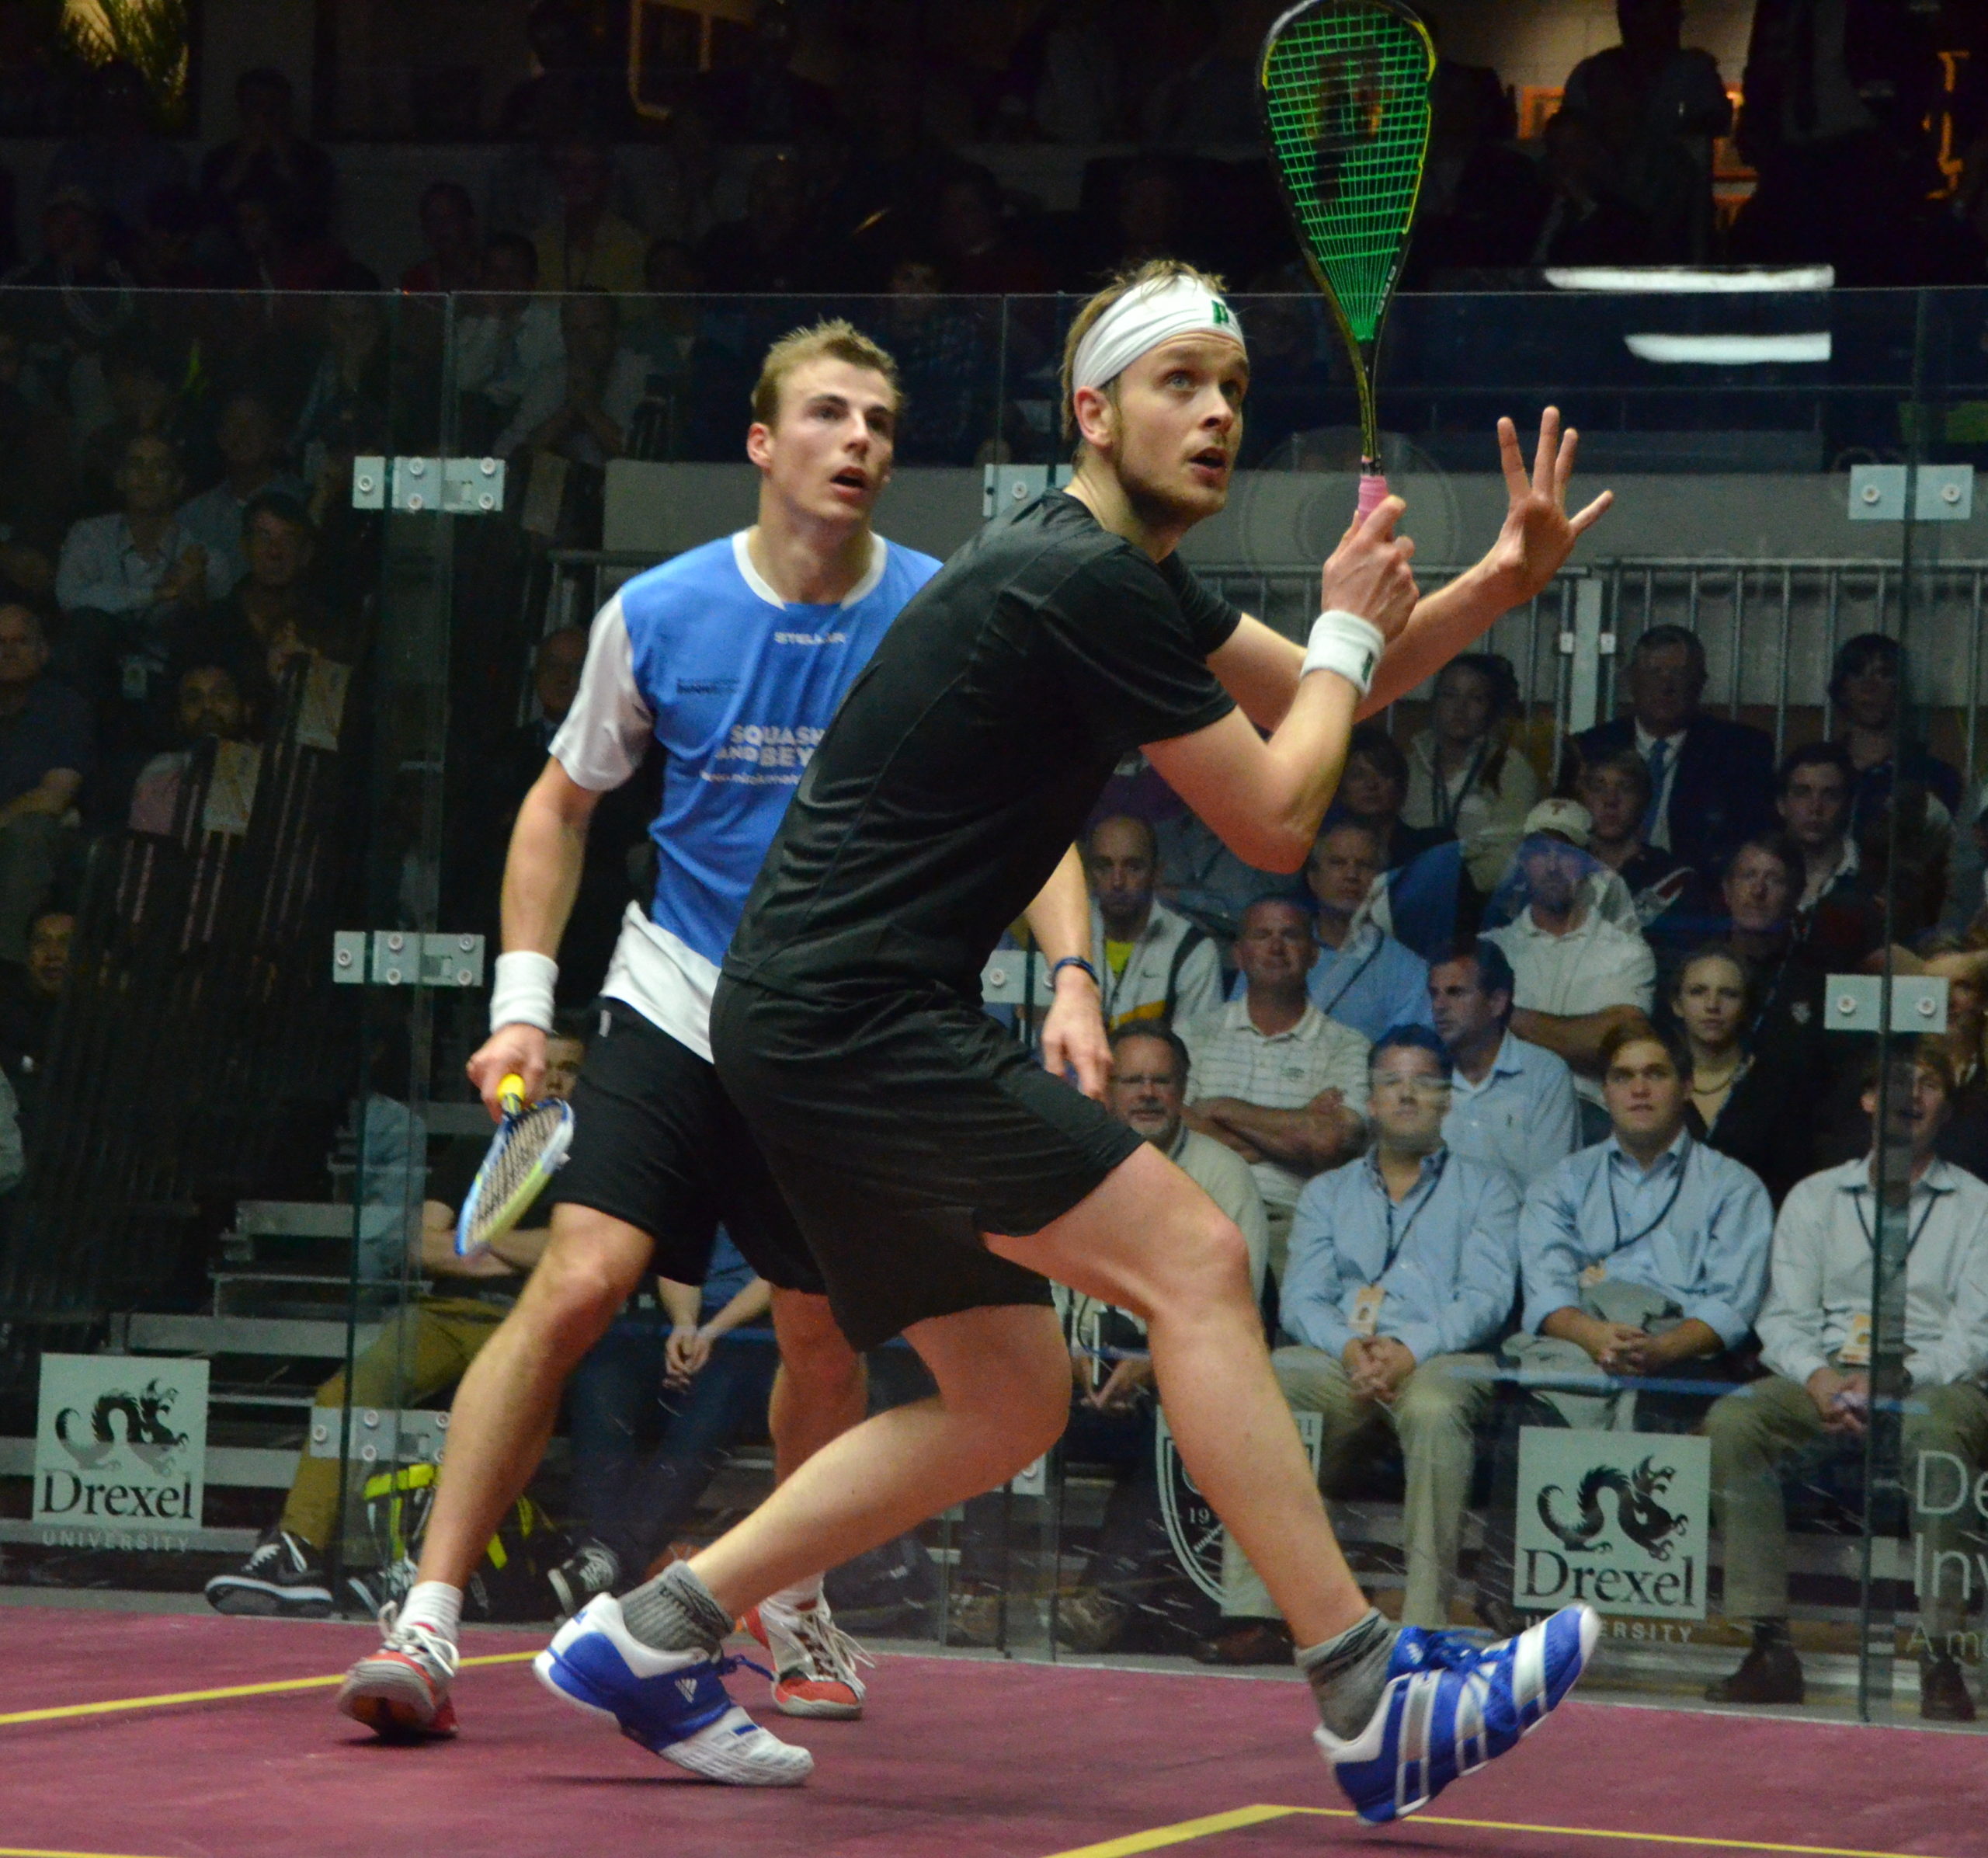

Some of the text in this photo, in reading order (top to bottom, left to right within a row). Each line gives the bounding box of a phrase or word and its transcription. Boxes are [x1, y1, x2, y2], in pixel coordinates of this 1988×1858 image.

[40, 1467, 194, 1519] Drexel
[42, 1529, 189, 1553] UNIVERSITY
[1521, 1548, 1695, 1607] Drexel
